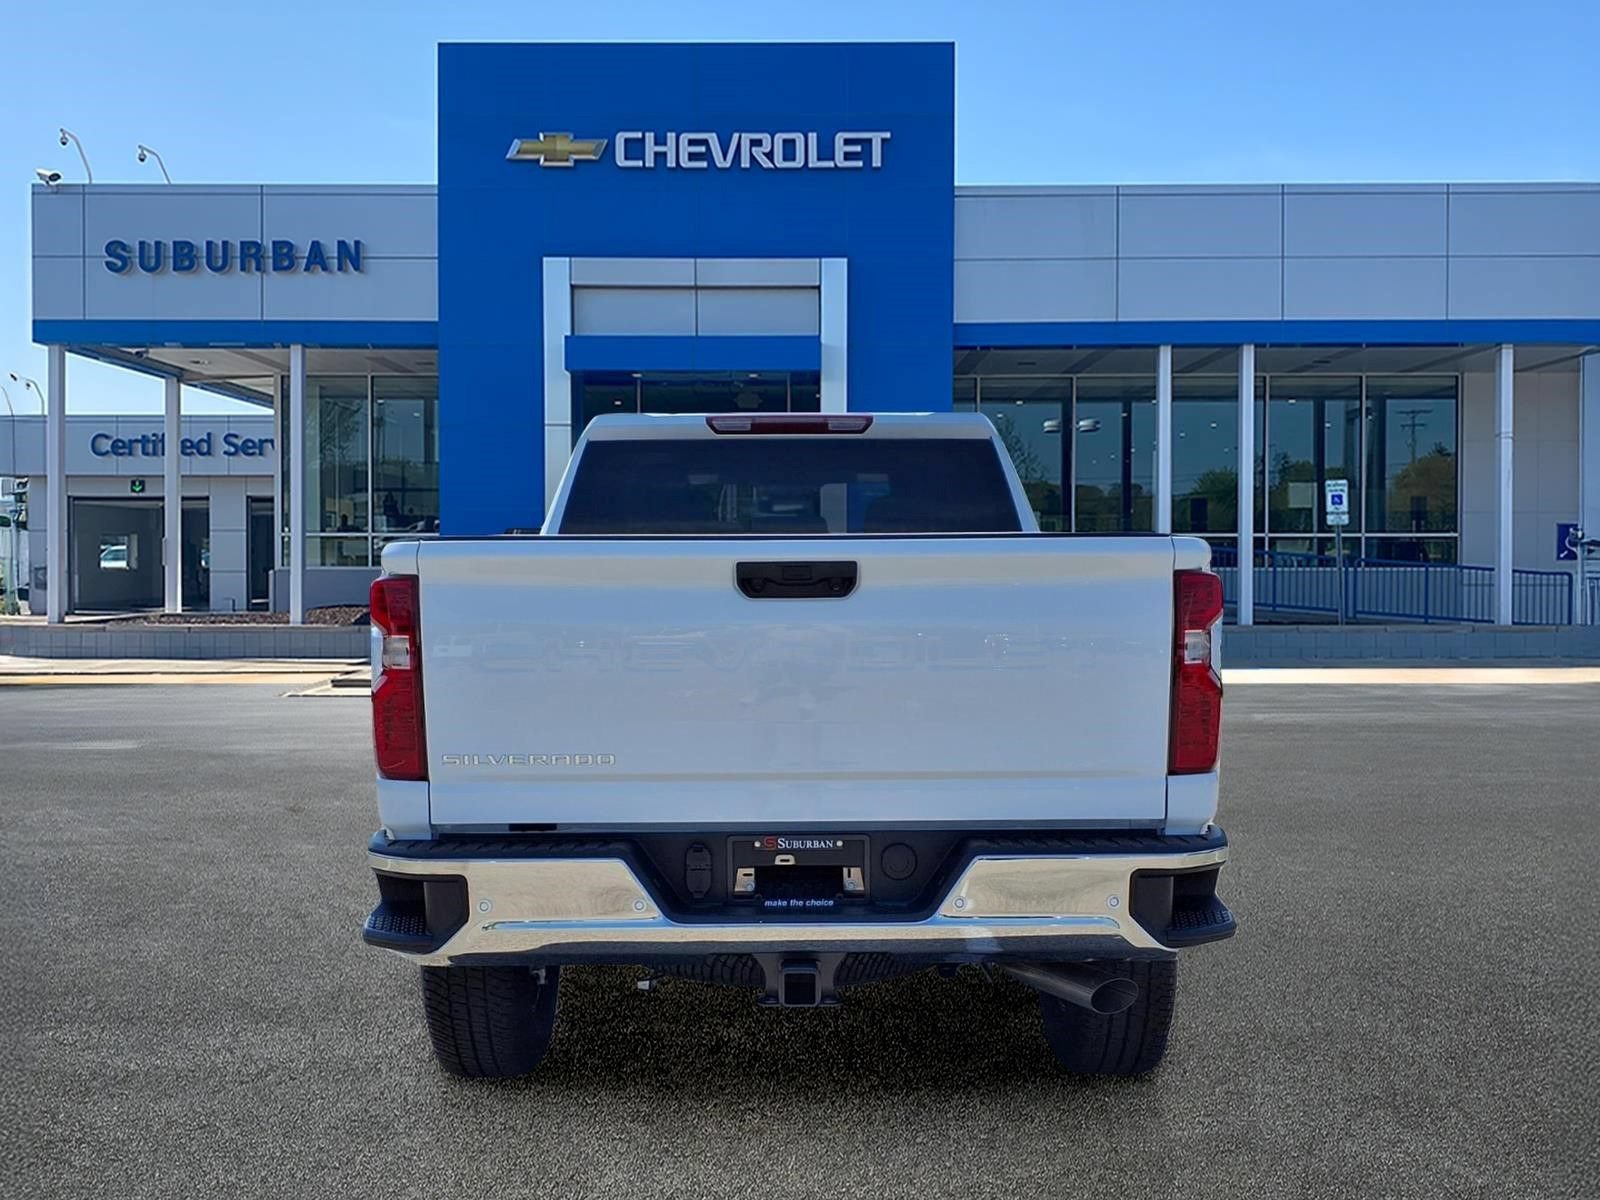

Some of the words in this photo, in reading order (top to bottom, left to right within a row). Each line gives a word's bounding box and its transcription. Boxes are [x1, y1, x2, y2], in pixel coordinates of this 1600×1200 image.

[615, 131, 891, 168] CHEVROLET
[104, 239, 362, 273] SUBURBAN
[441, 753, 617, 767] SILVERADO
[764, 899, 788, 907] make
[790, 898, 804, 907] the
[805, 898, 834, 907] choice
